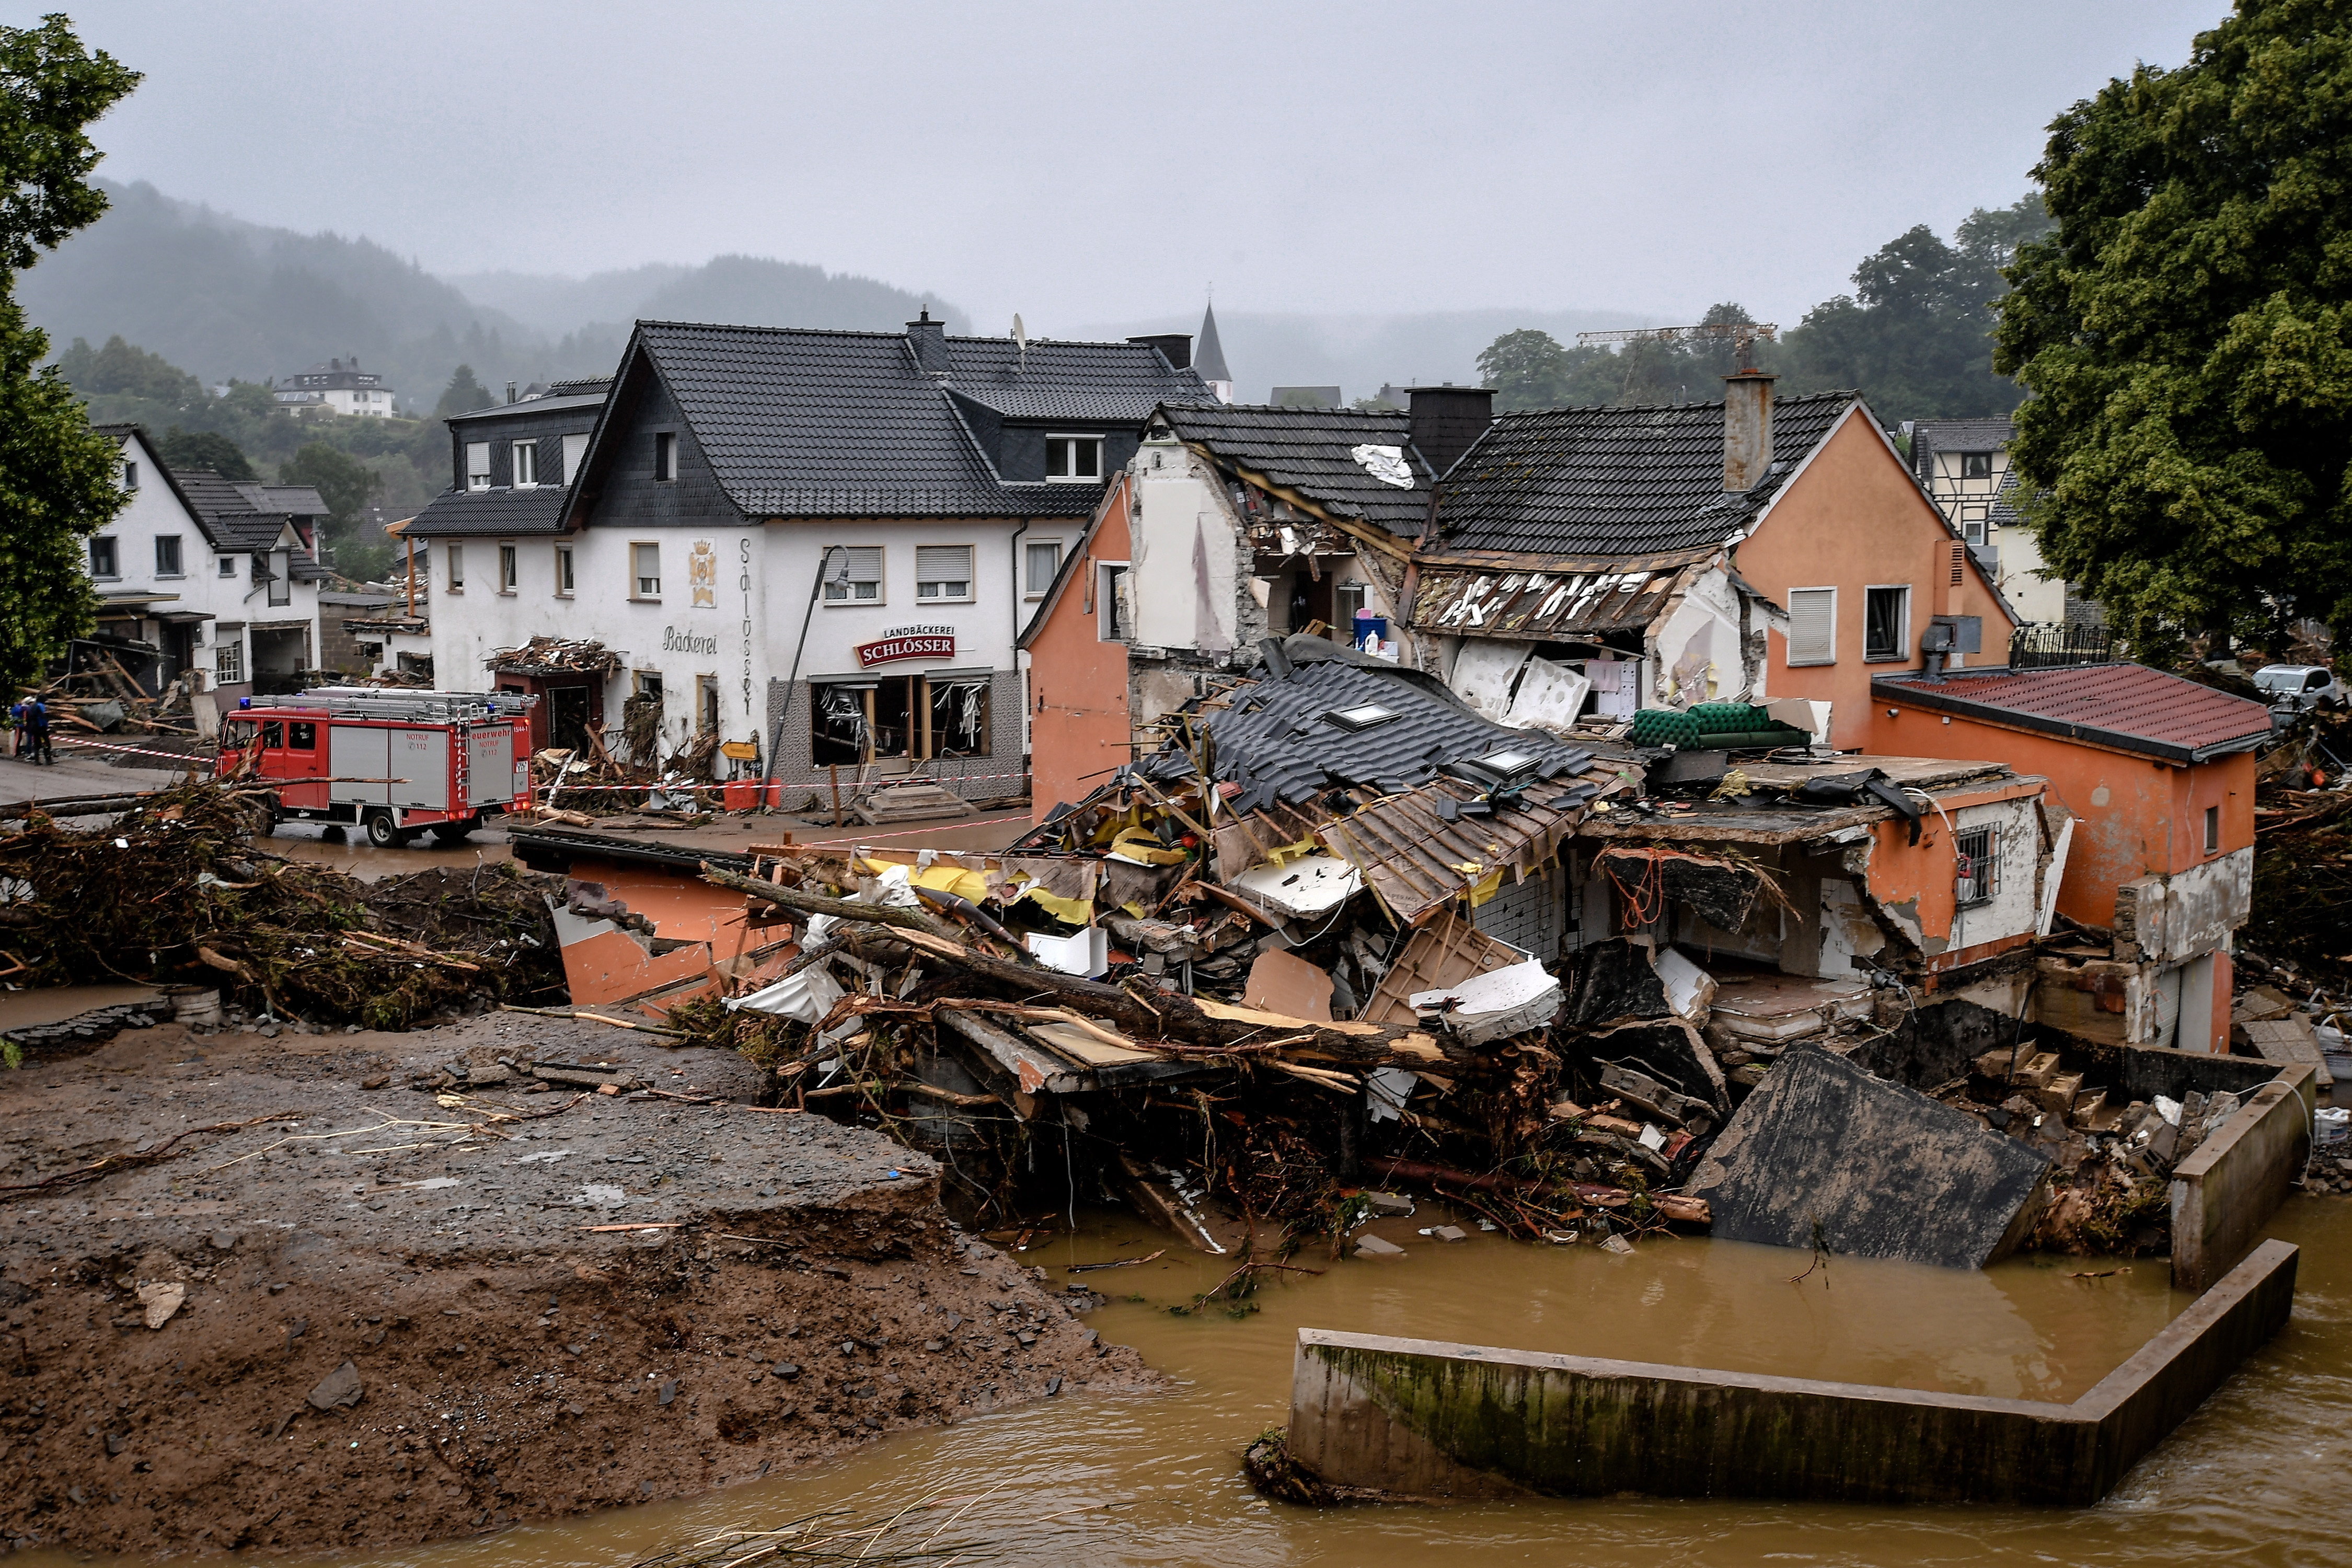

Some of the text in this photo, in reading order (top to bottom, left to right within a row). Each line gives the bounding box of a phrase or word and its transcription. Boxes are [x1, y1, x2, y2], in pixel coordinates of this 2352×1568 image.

[662, 626, 717, 654] Bäckerei
[884, 625, 954, 638] LANDBÄCKEREI
[863, 639, 952, 662] SCHLÖSSER
[471, 729, 510, 740] euerwehr
